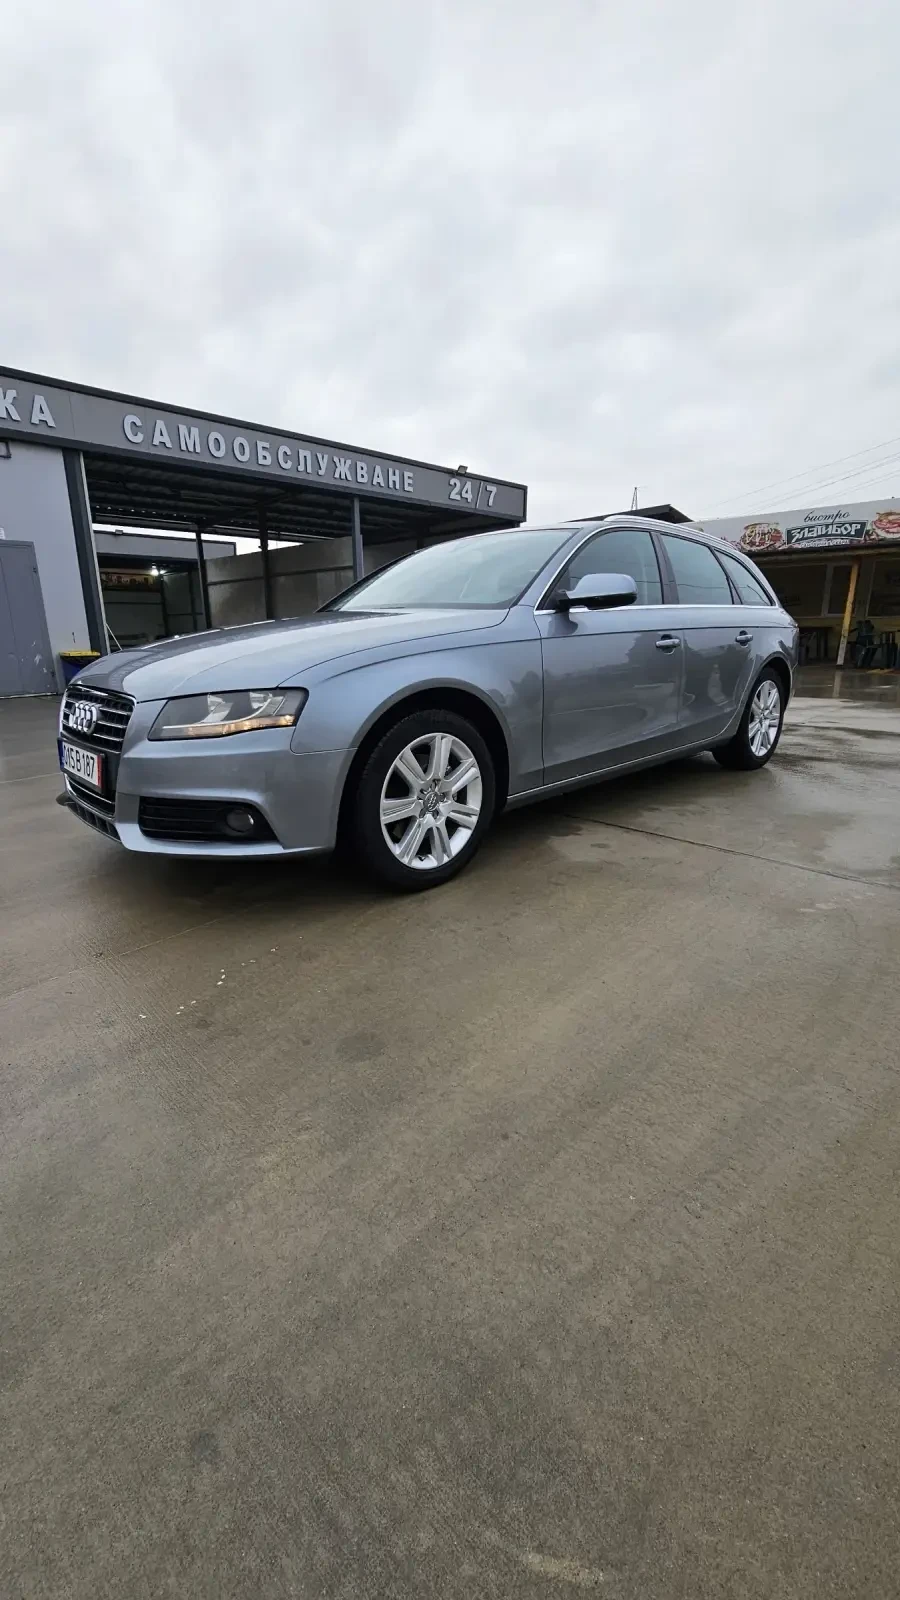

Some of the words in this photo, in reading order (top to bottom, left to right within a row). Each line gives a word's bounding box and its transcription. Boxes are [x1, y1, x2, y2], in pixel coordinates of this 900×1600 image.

[123, 414, 415, 493] САМООБСЛУЖВАНЕ
[449, 478, 497, 509] 24/7
[803, 510, 850, 524] бистро
